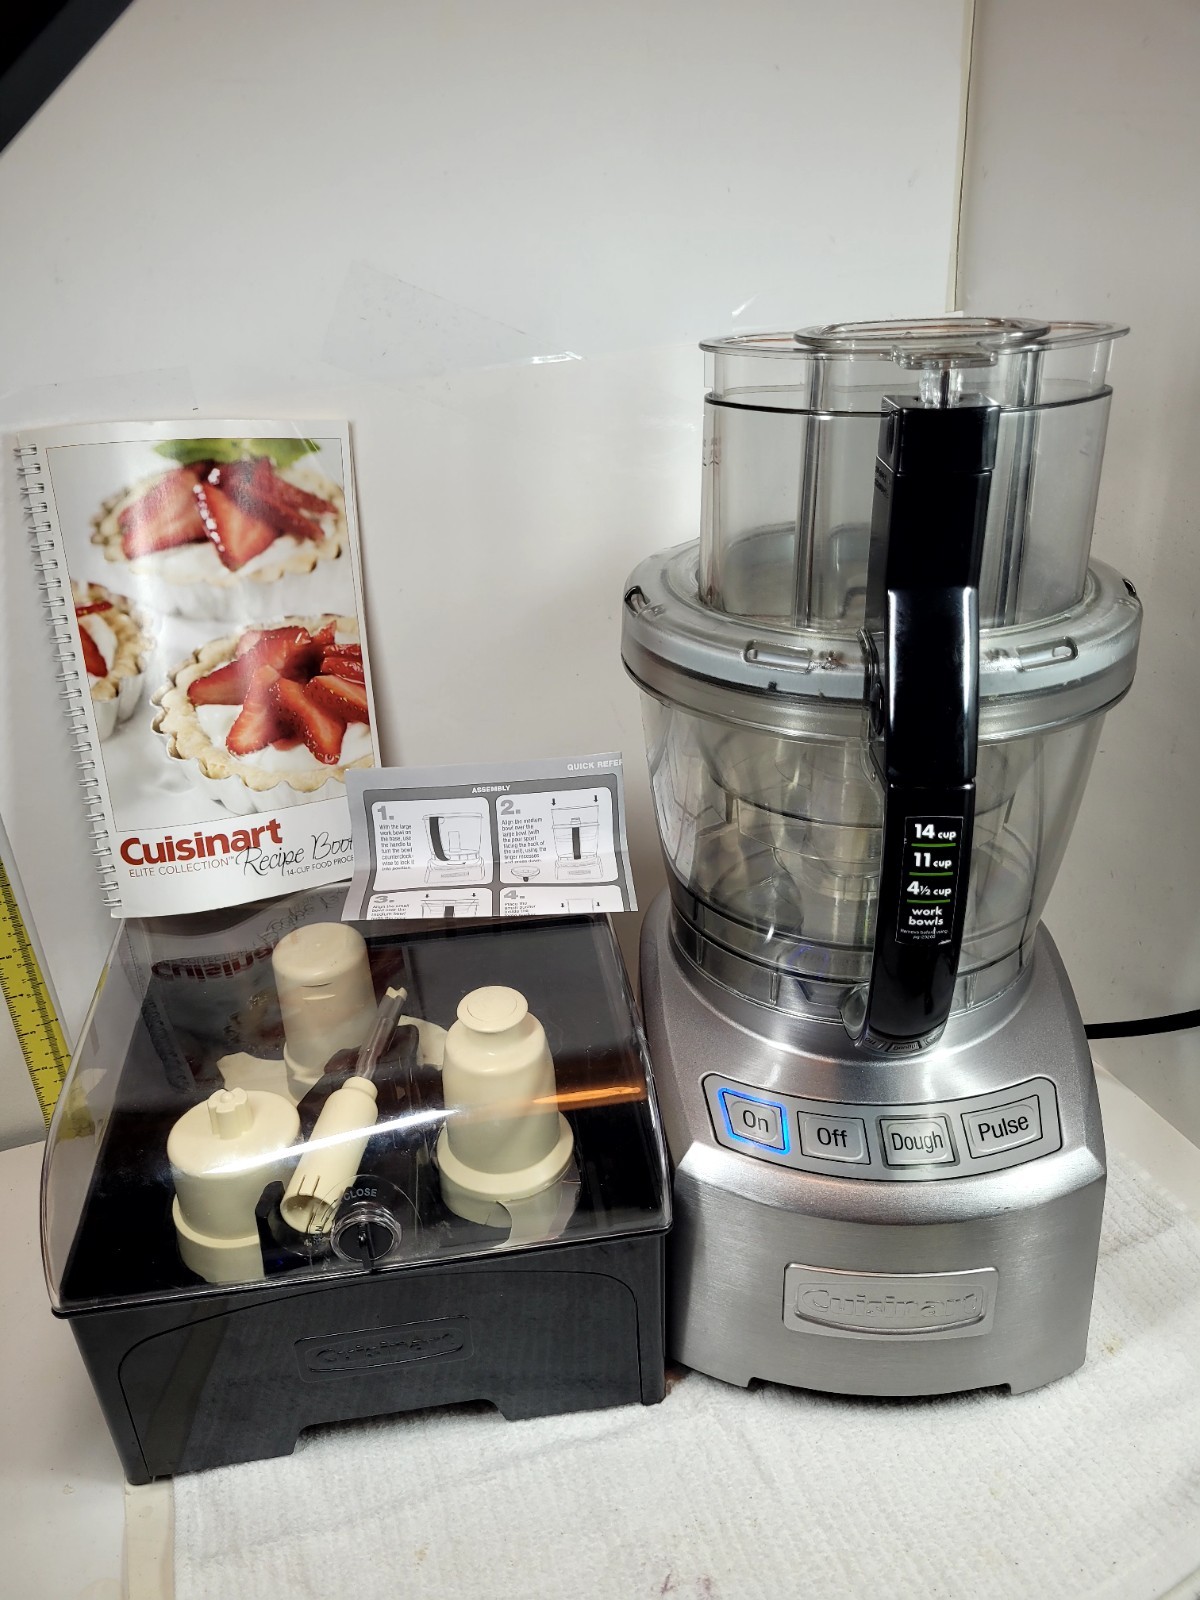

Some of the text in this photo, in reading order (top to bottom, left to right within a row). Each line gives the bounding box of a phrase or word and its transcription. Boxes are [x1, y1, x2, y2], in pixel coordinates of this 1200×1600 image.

[567, 762, 594, 771] QUICK
[471, 785, 511, 794] ASSEMBLY
[377, 805, 395, 821] 1.
[500, 799, 521, 815] 2.
[914, 823, 957, 841] 14 cup
[119, 818, 283, 866] Cuisinart
[235, 845, 305, 877] Recipe
[286, 866, 310, 876] 14-CUP
[312, 860, 333, 870] FOOD
[914, 852, 952, 869] 11 cup
[128, 866, 156, 878] ELITE
[374, 895, 395, 903] 3.
[504, 890, 525, 900] 4.
[933, 888, 952, 897] cup
[911, 906, 943, 916] work
[908, 916, 944, 926] bowls
[742, 1110, 769, 1133] On
[977, 1112, 1030, 1141] Pulse
[816, 1127, 848, 1148] Off
[890, 1131, 944, 1154] Dough
[343, 1187, 378, 1201] CLOSE
[802, 1289, 978, 1318] Cuisinart
